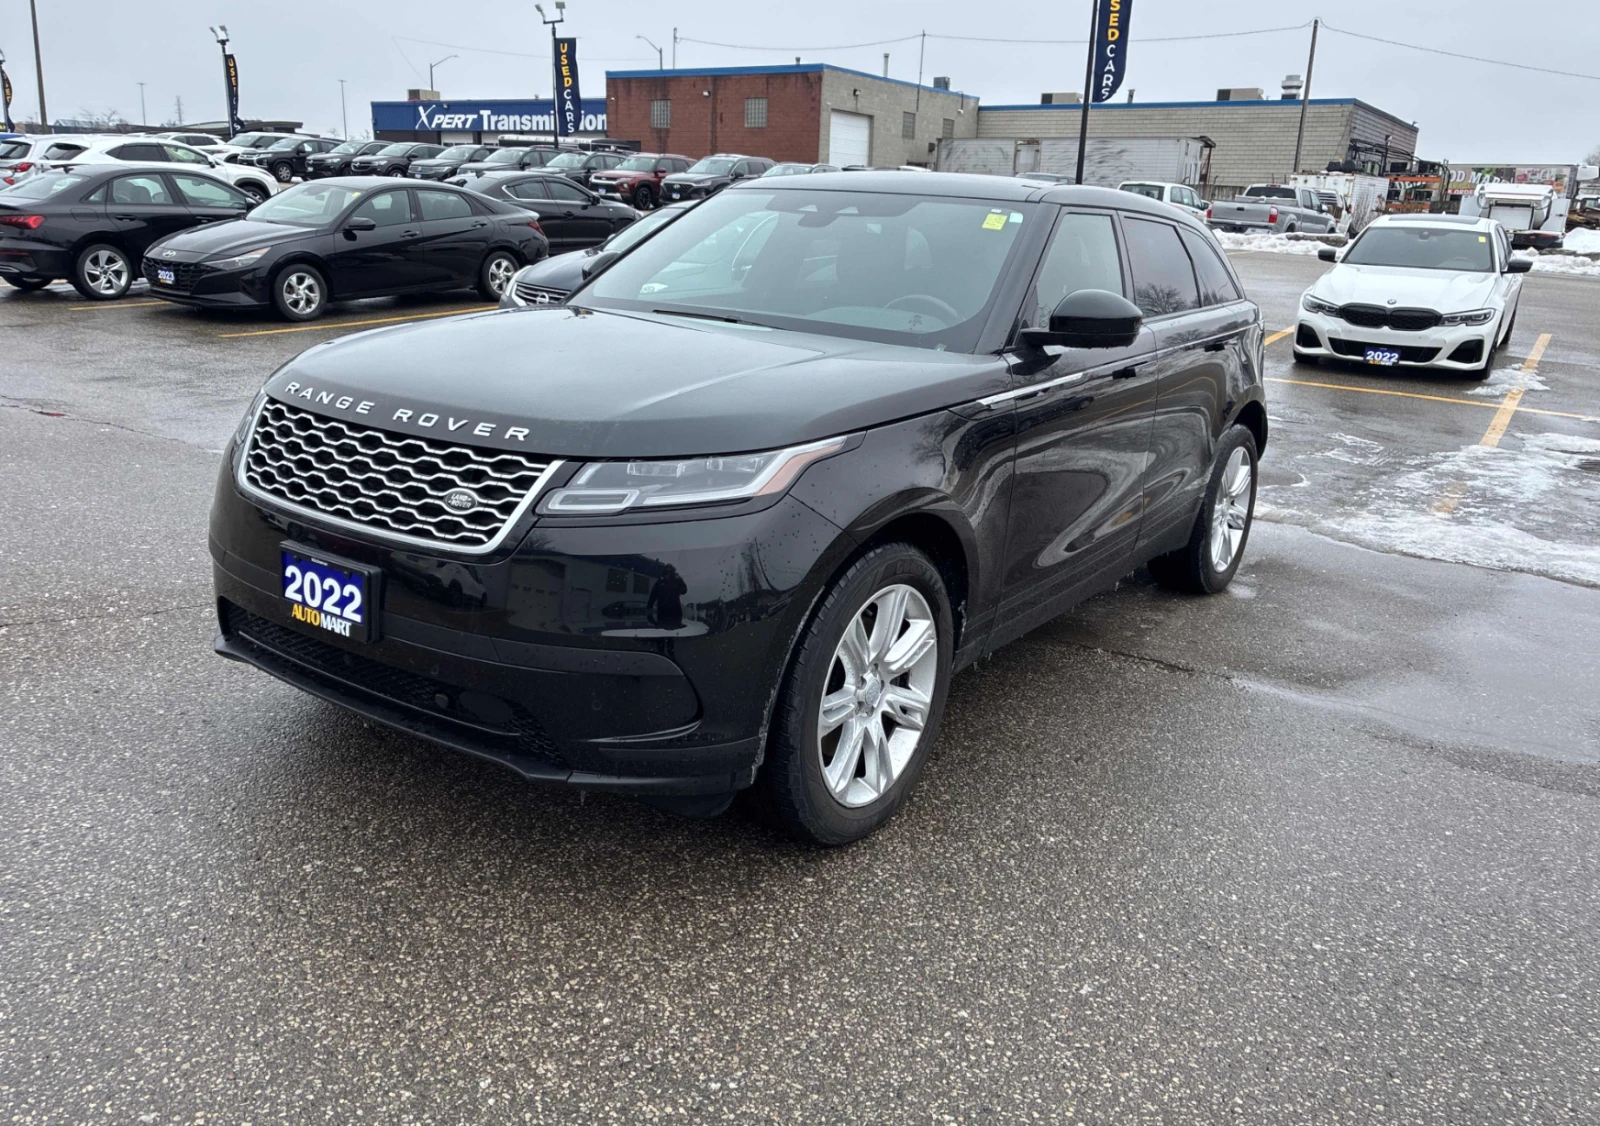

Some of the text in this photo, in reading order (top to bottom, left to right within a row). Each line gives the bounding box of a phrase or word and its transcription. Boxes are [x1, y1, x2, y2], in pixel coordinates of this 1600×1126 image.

[1101, 0, 1120, 99] SED CARS
[560, 43, 575, 133] USED CARS
[415, 104, 607, 131] XPERT Transmiion
[158, 269, 174, 281] 2023
[1366, 350, 1399, 363] 2022
[284, 381, 530, 441] RANGE ROVER
[450, 500, 472, 509] ROVER
[451, 493, 469, 502] LAND
[284, 564, 362, 623] 2022
[291, 603, 352, 638] AUTOMART
